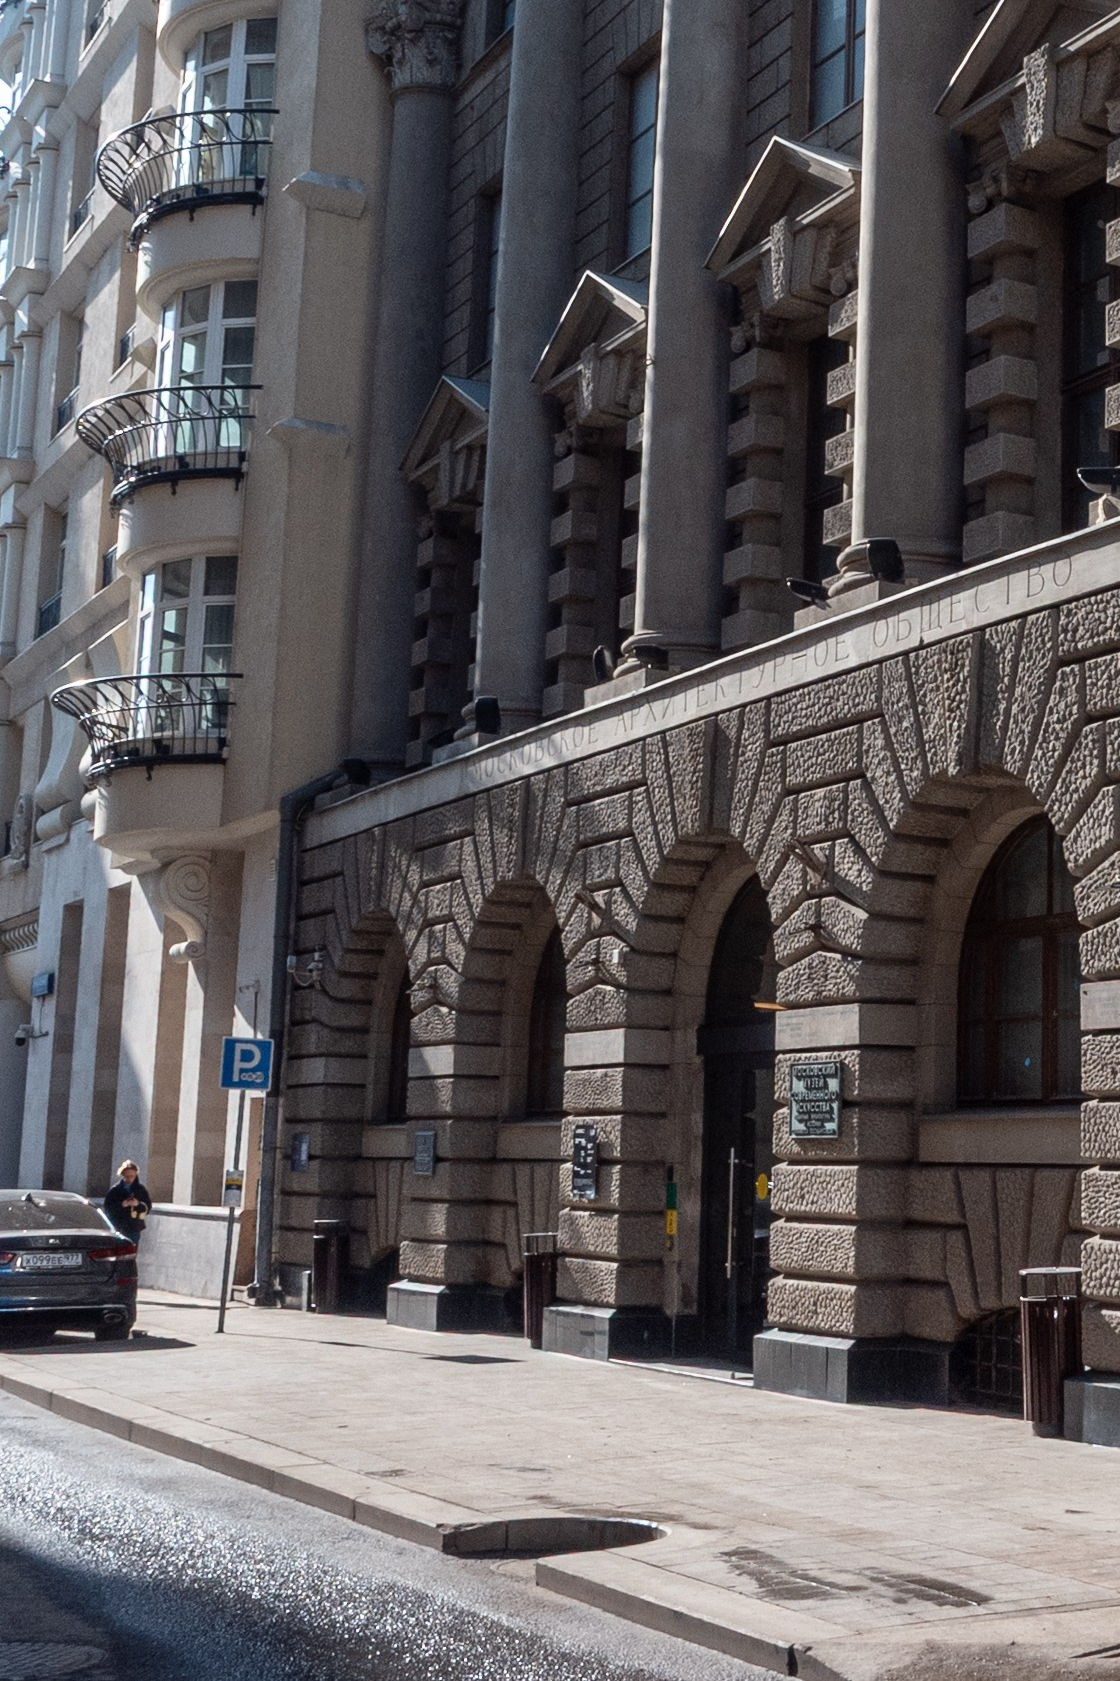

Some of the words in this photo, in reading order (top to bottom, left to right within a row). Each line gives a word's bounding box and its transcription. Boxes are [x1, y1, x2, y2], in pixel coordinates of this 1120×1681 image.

[471, 721, 600, 781] МОСКОВСКОЕ
[613, 634, 850, 736] АРХИТЕКТУРНОЕ
[872, 554, 1073, 648] ОБЩЕСТВО
[232, 1042, 261, 1083] P
[792, 1064, 836, 1076] МОСКОВСКИЙ
[803, 1075, 825, 1088] МУЗЕЙ
[790, 1089, 837, 1101] СОВРЕМЕННОГО
[795, 1101, 831, 1112] ИСКУССТВА
